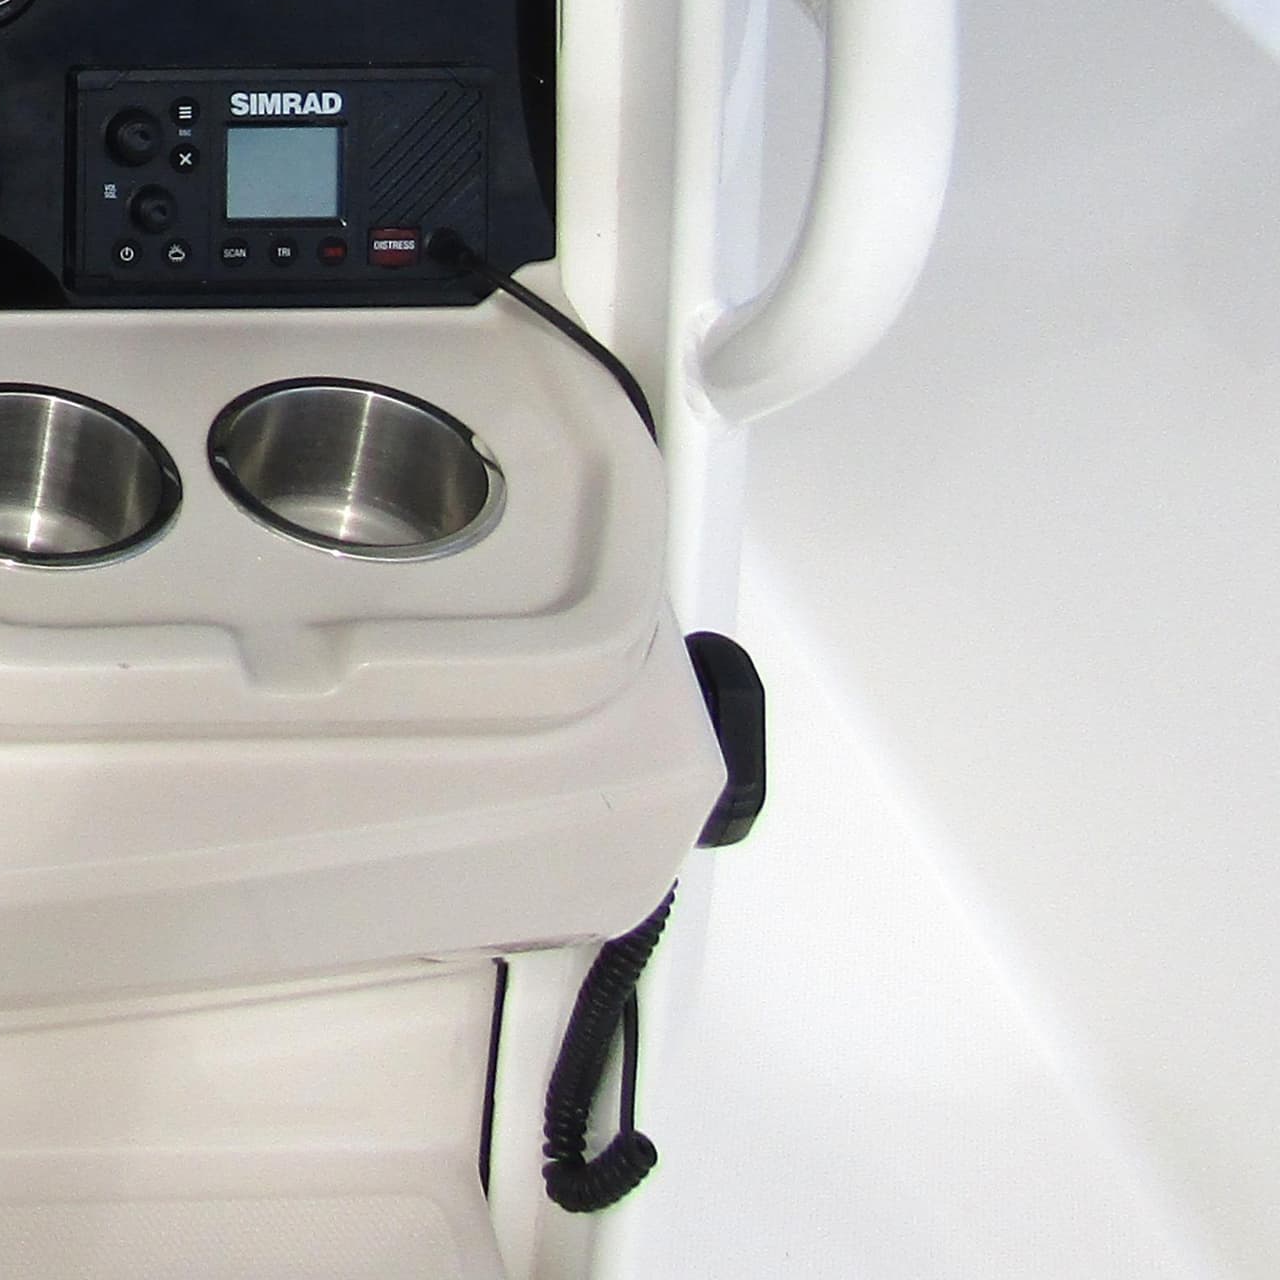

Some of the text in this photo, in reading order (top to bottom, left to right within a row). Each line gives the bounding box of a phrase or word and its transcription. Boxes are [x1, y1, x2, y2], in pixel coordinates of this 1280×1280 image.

[230, 92, 342, 116] SIMRAD
[373, 240, 415, 251] DISTRESS
[223, 248, 247, 258] SCAN
[277, 248, 291, 257] TRI
